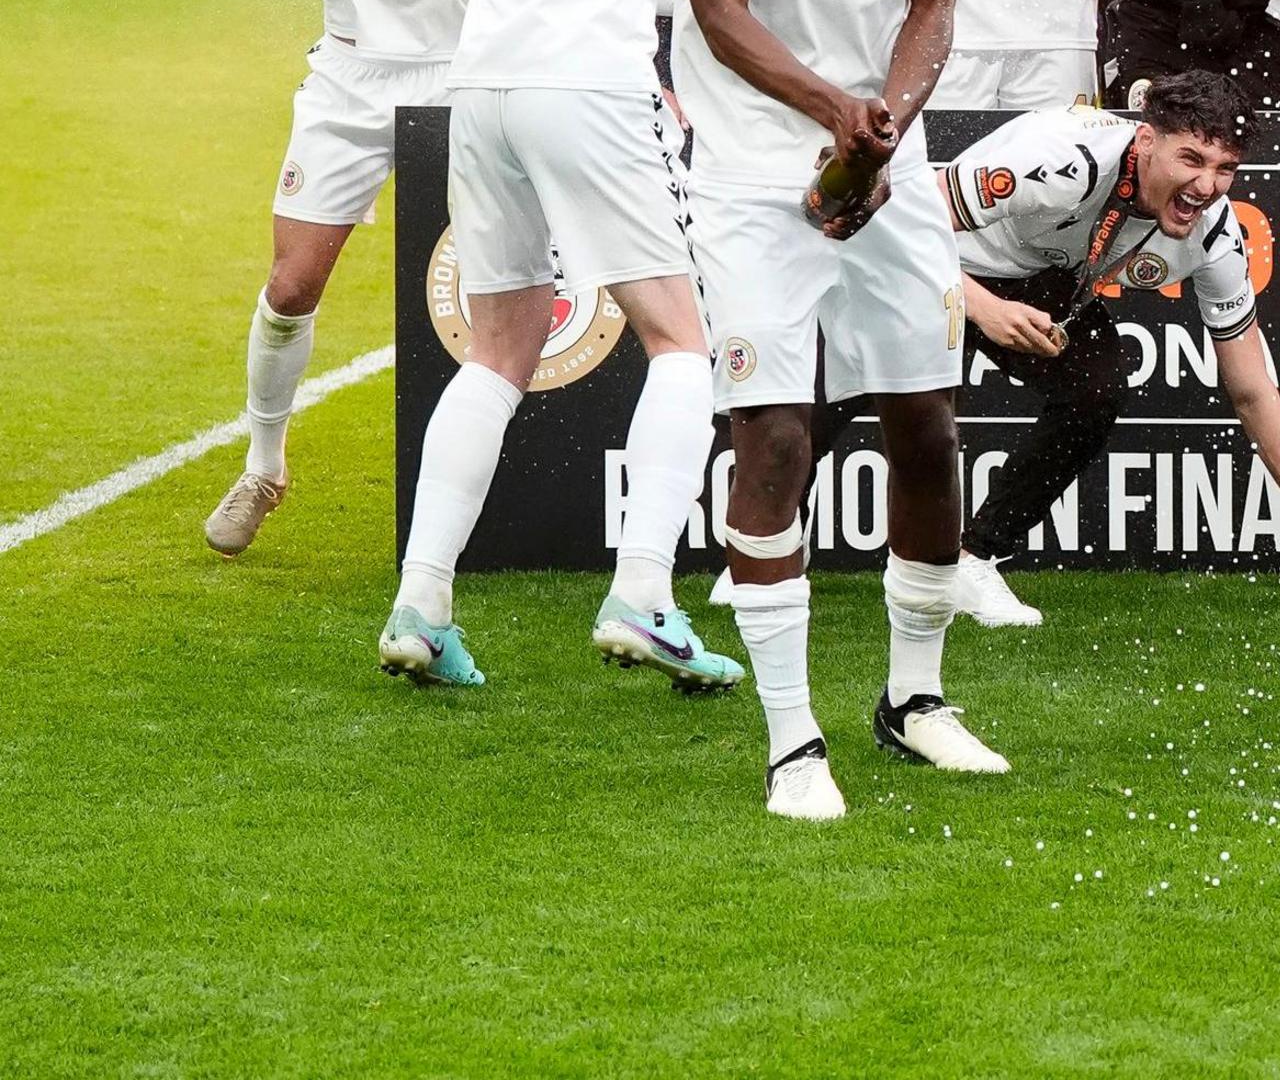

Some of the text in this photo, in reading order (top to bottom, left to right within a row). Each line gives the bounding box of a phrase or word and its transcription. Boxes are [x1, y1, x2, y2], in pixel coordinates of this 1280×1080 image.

[1126, 145, 1139, 180] vana
[432, 234, 458, 318] BROM
[561, 345, 595, 375] 1892
